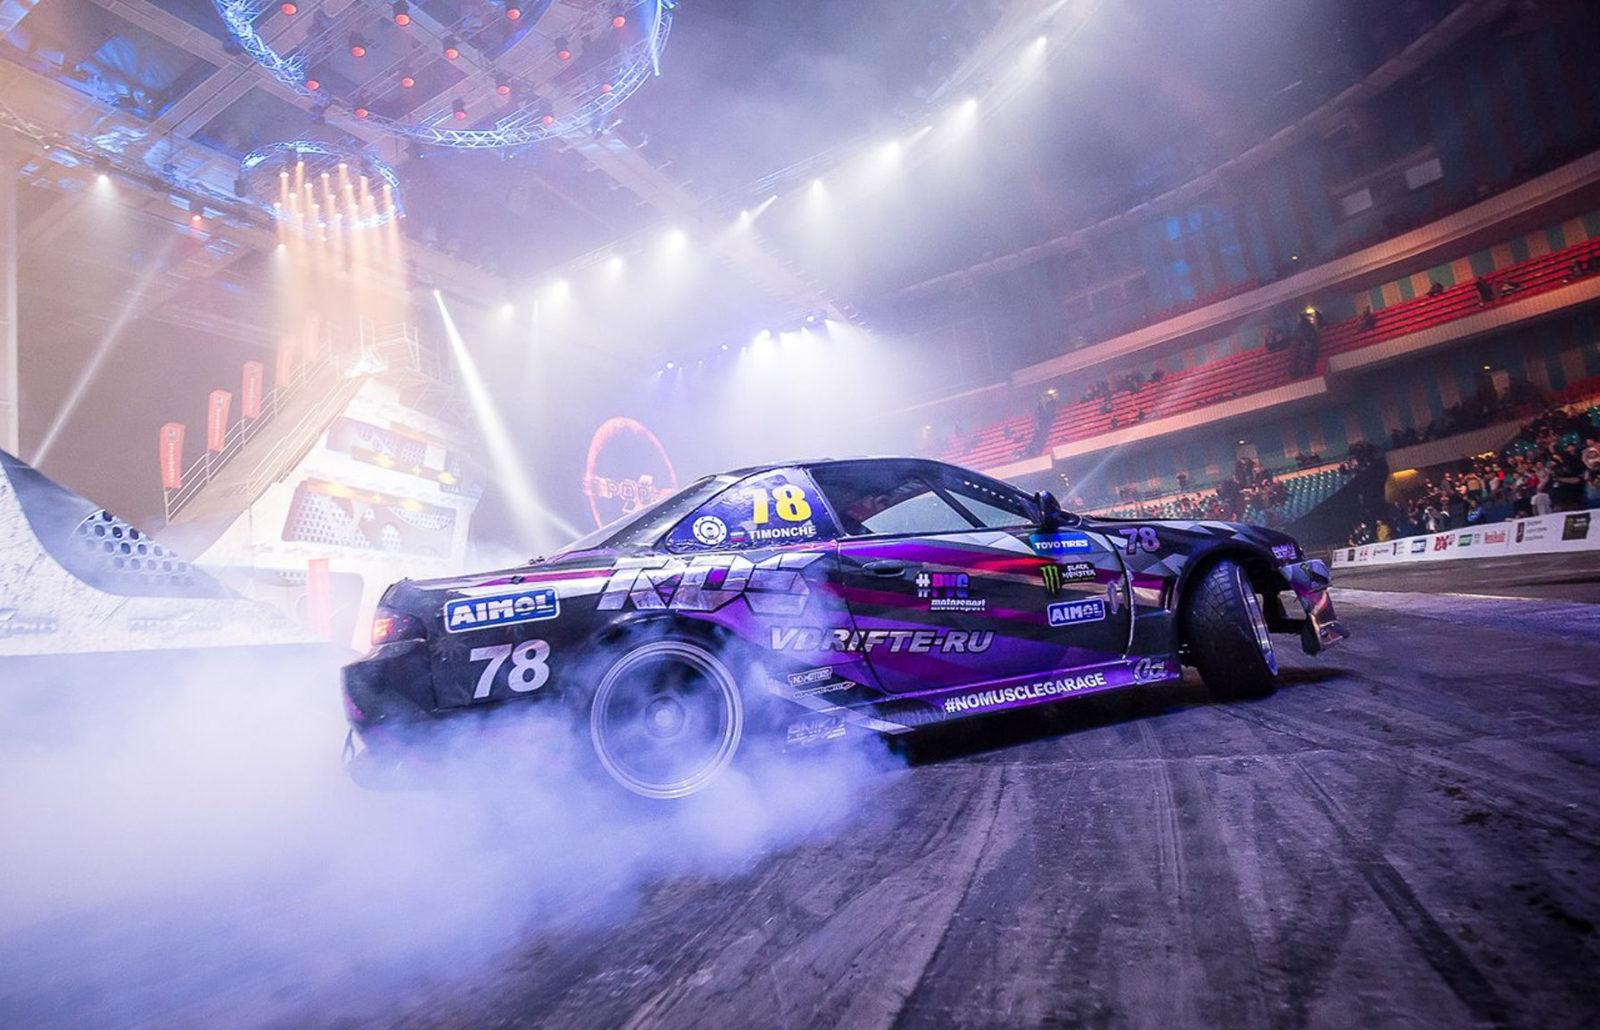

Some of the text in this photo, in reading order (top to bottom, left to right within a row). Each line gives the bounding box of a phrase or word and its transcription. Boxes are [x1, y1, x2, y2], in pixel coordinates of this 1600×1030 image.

[739, 484, 813, 524] 78
[748, 525, 817, 539] TIMONCHE
[1035, 539, 1088, 549] TOYO TIRES
[1119, 527, 1160, 553] 78
[450, 594, 555, 627] AIMOL
[1051, 602, 1102, 622] AIMOL
[469, 639, 551, 699] 78
[945, 672, 1107, 713] #NOMUSCLEGARAGE
